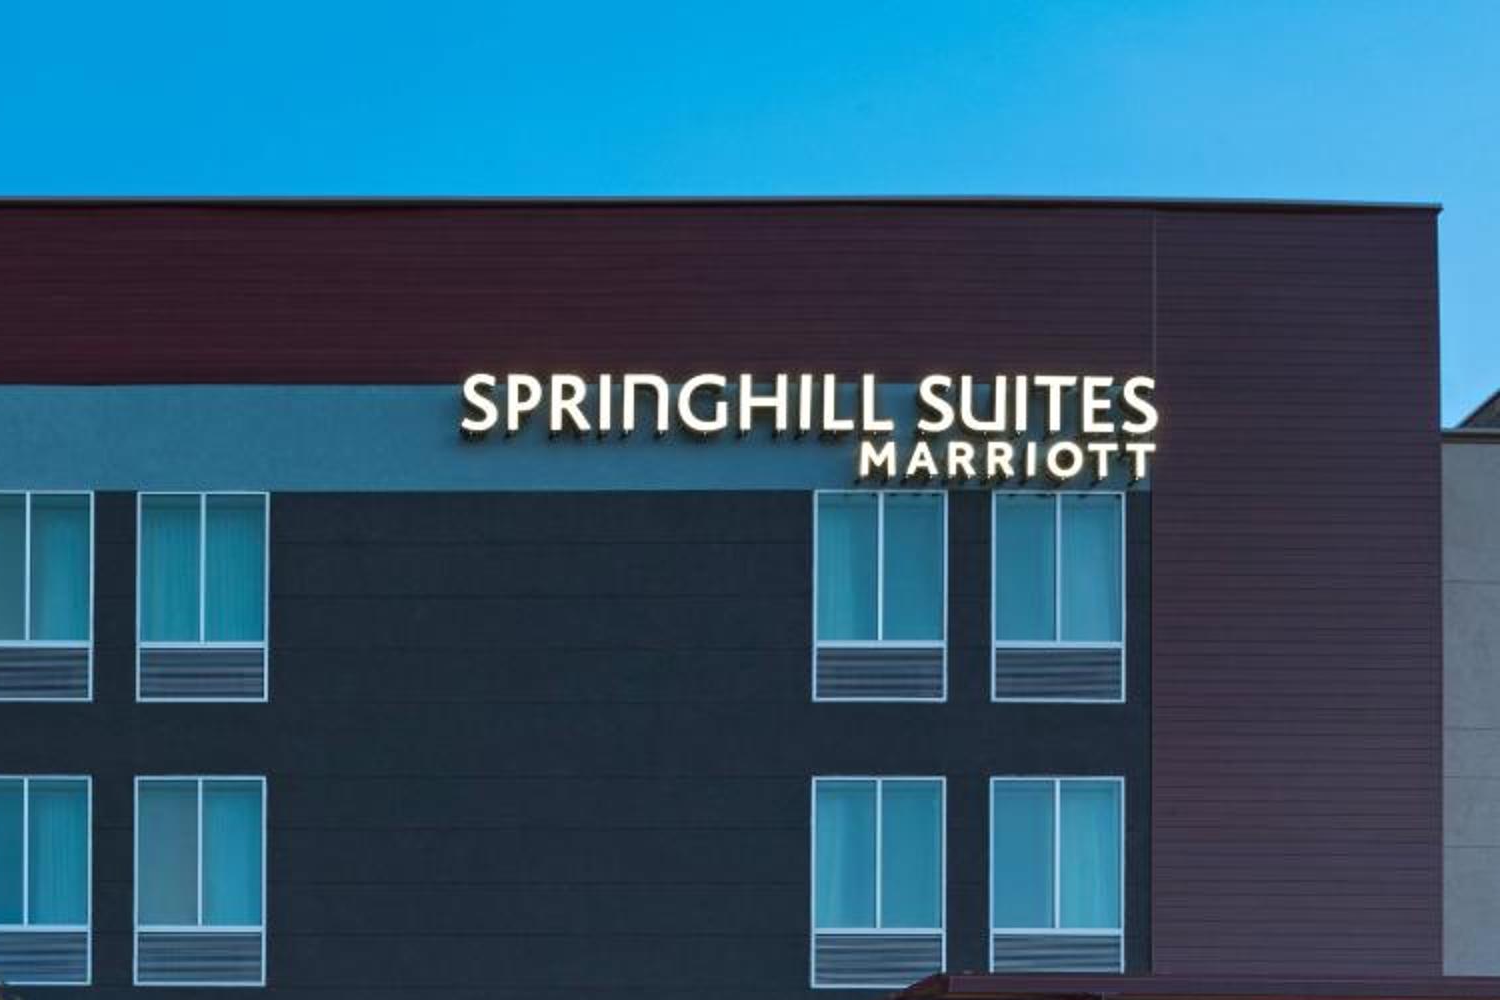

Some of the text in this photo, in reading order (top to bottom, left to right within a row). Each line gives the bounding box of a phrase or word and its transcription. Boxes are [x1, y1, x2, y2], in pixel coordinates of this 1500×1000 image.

[461, 373, 1159, 434] SPRINGHILL SUITES
[859, 440, 1157, 478] MARRIOTT
